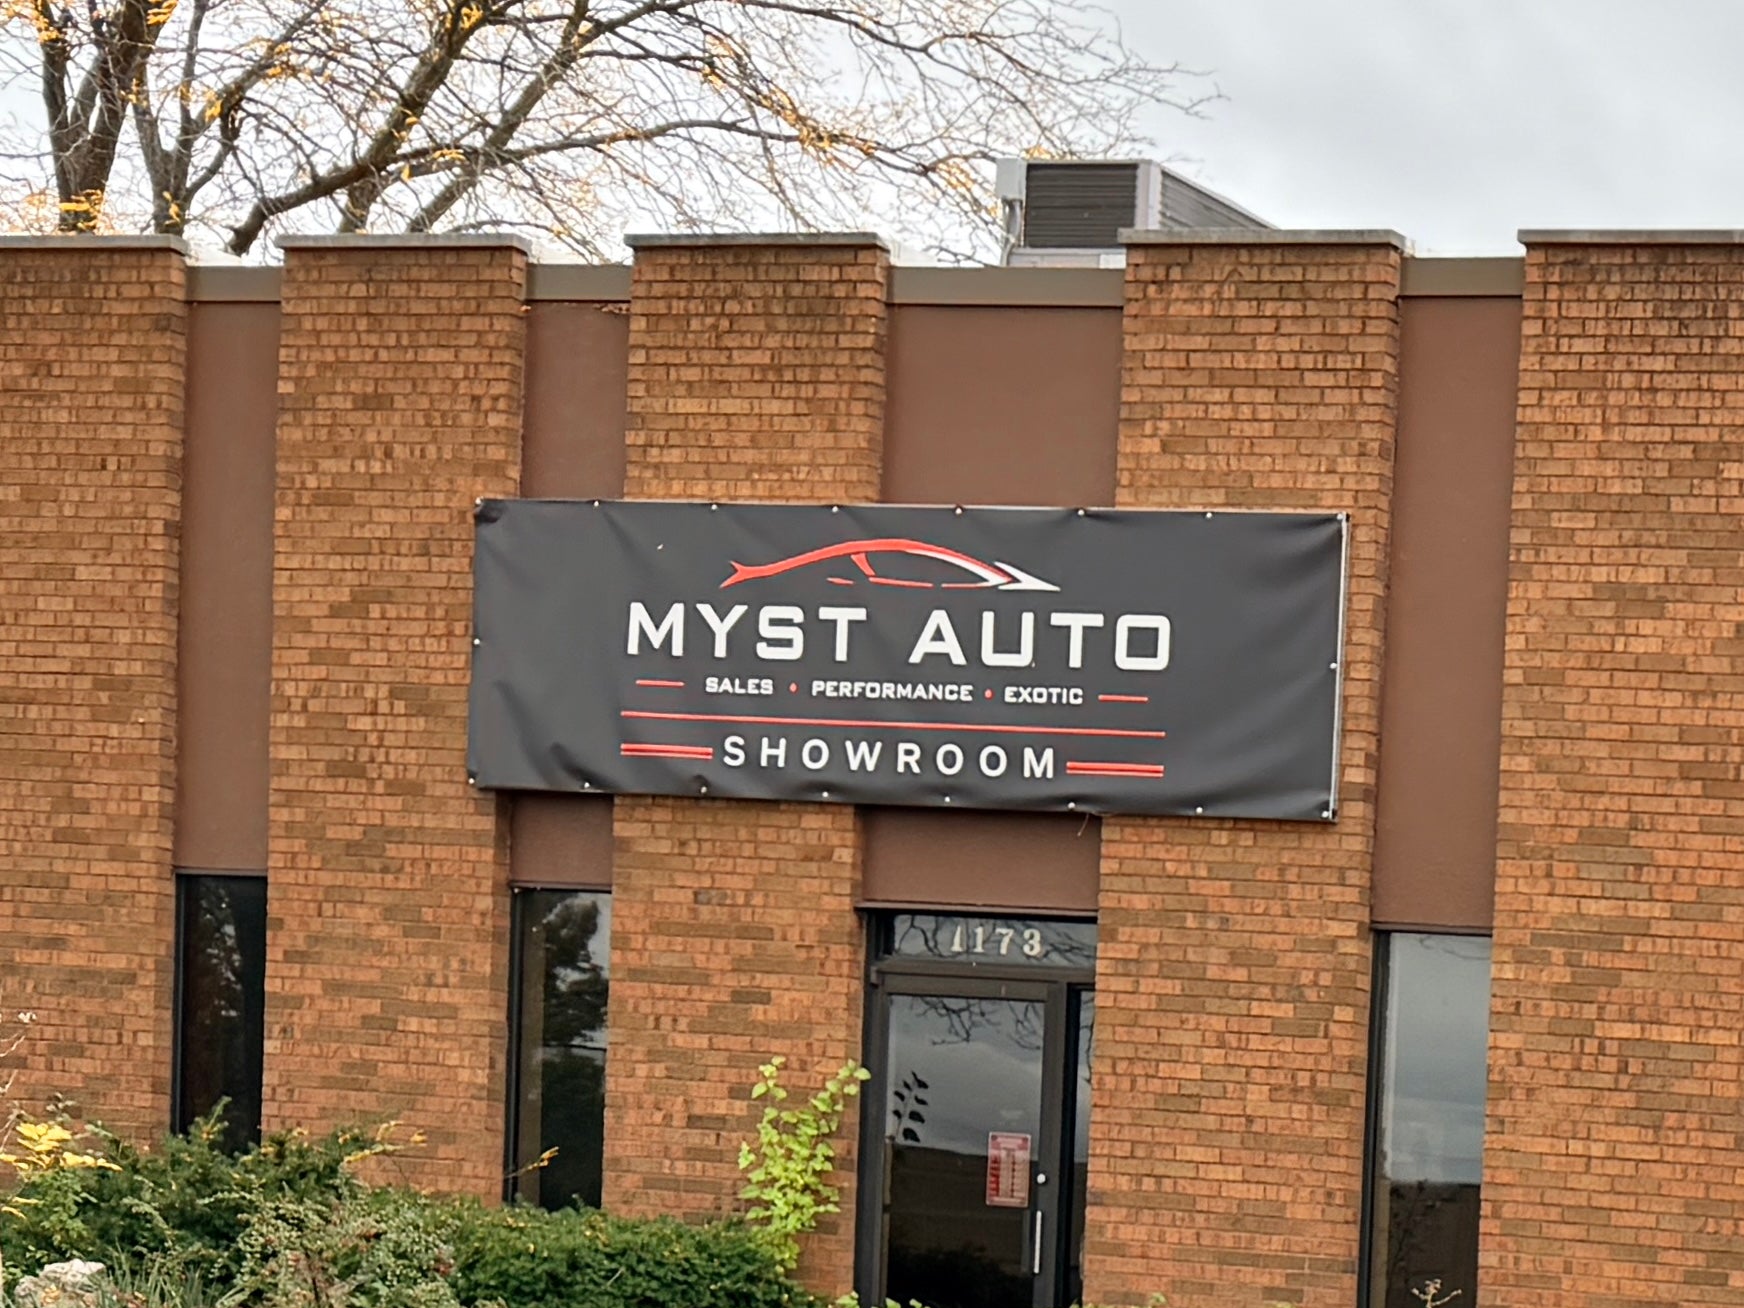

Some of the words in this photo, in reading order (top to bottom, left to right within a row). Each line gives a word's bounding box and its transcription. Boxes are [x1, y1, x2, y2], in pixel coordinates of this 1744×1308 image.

[627, 601, 867, 662] MYST
[908, 609, 1171, 671] AUTO
[705, 676, 774, 695] SALES
[811, 680, 974, 702] PERFORMANCE
[1004, 686, 1084, 705] EXOTIC
[723, 735, 1055, 779] SHOWROOM
[950, 925, 1041, 956] 1173
